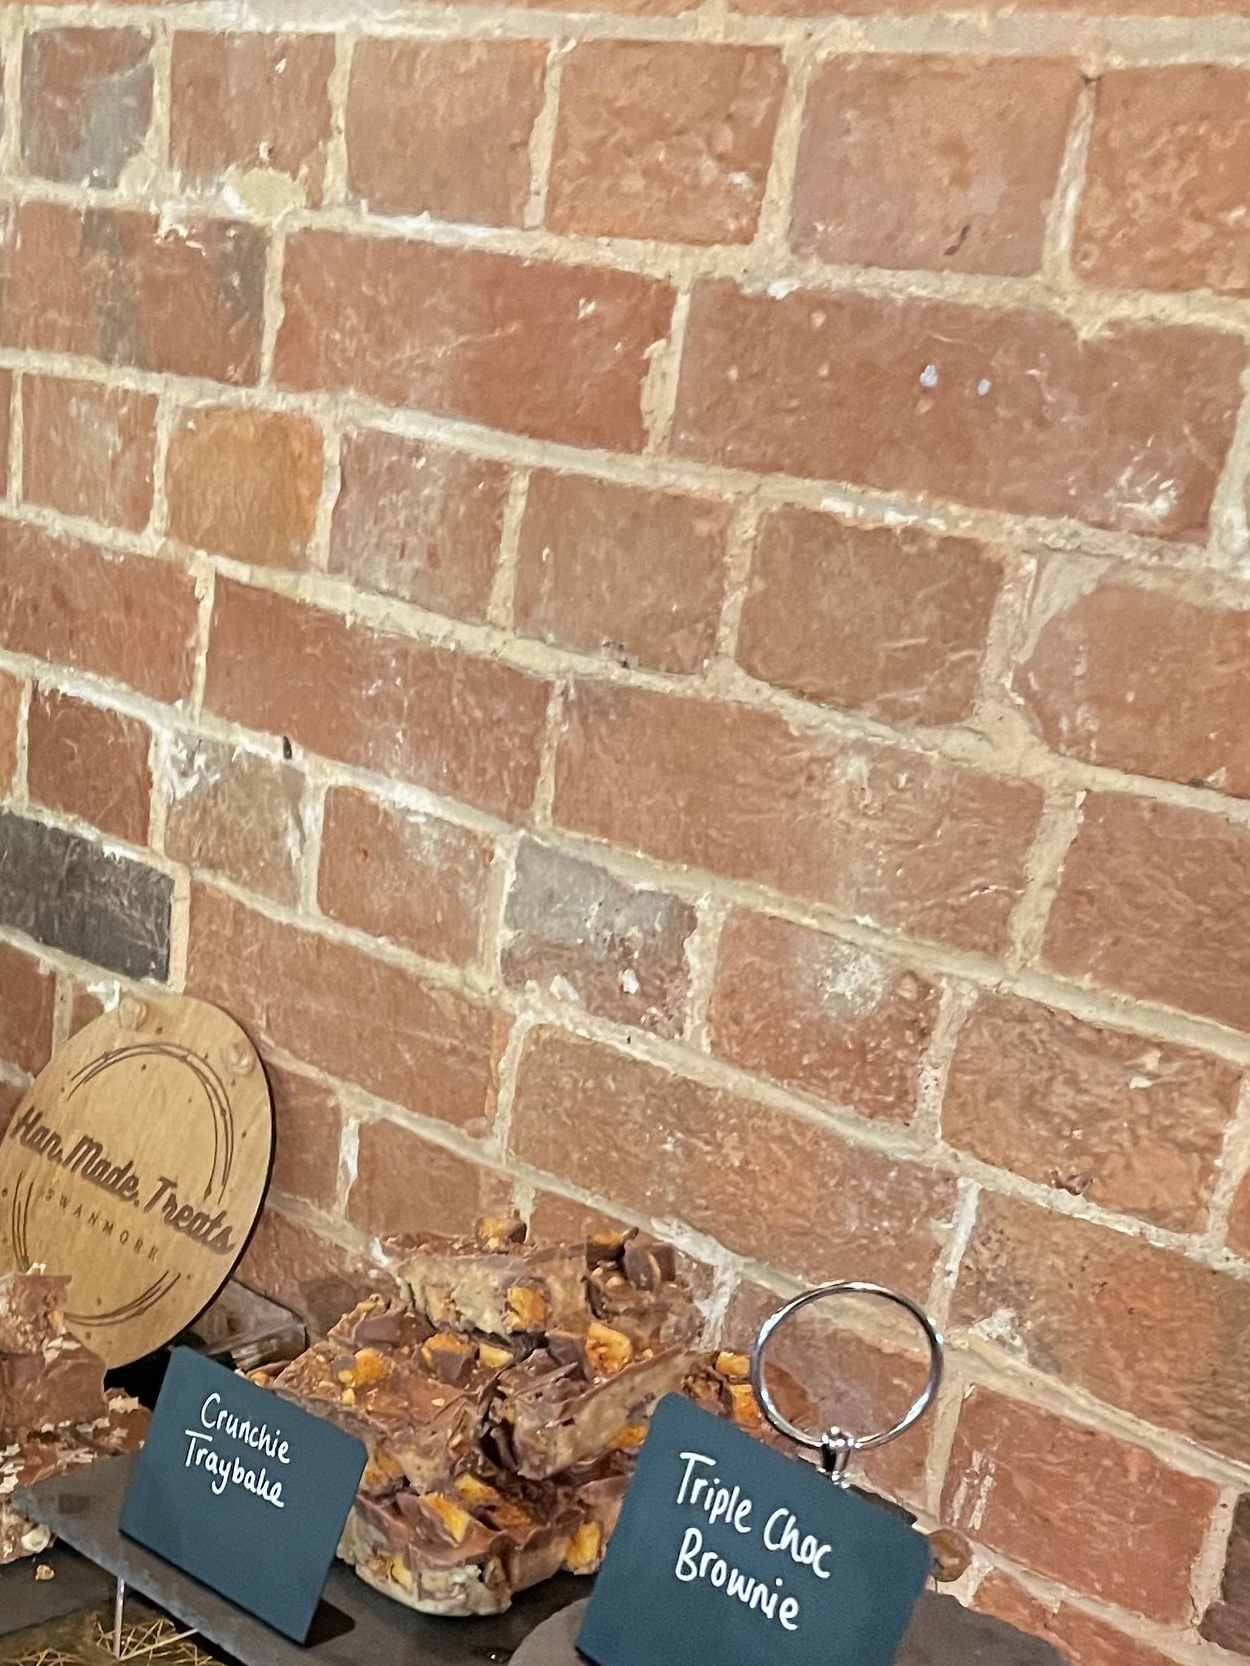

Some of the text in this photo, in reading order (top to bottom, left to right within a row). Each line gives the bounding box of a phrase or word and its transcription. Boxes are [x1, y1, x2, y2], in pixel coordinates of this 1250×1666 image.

[143, 1175, 236, 1255] Treats
[200, 1392, 291, 1464] Crunchie
[184, 1429, 285, 1508] Traybake
[676, 1452, 833, 1579] Triple Choc
[674, 1526, 799, 1631] Brownie
